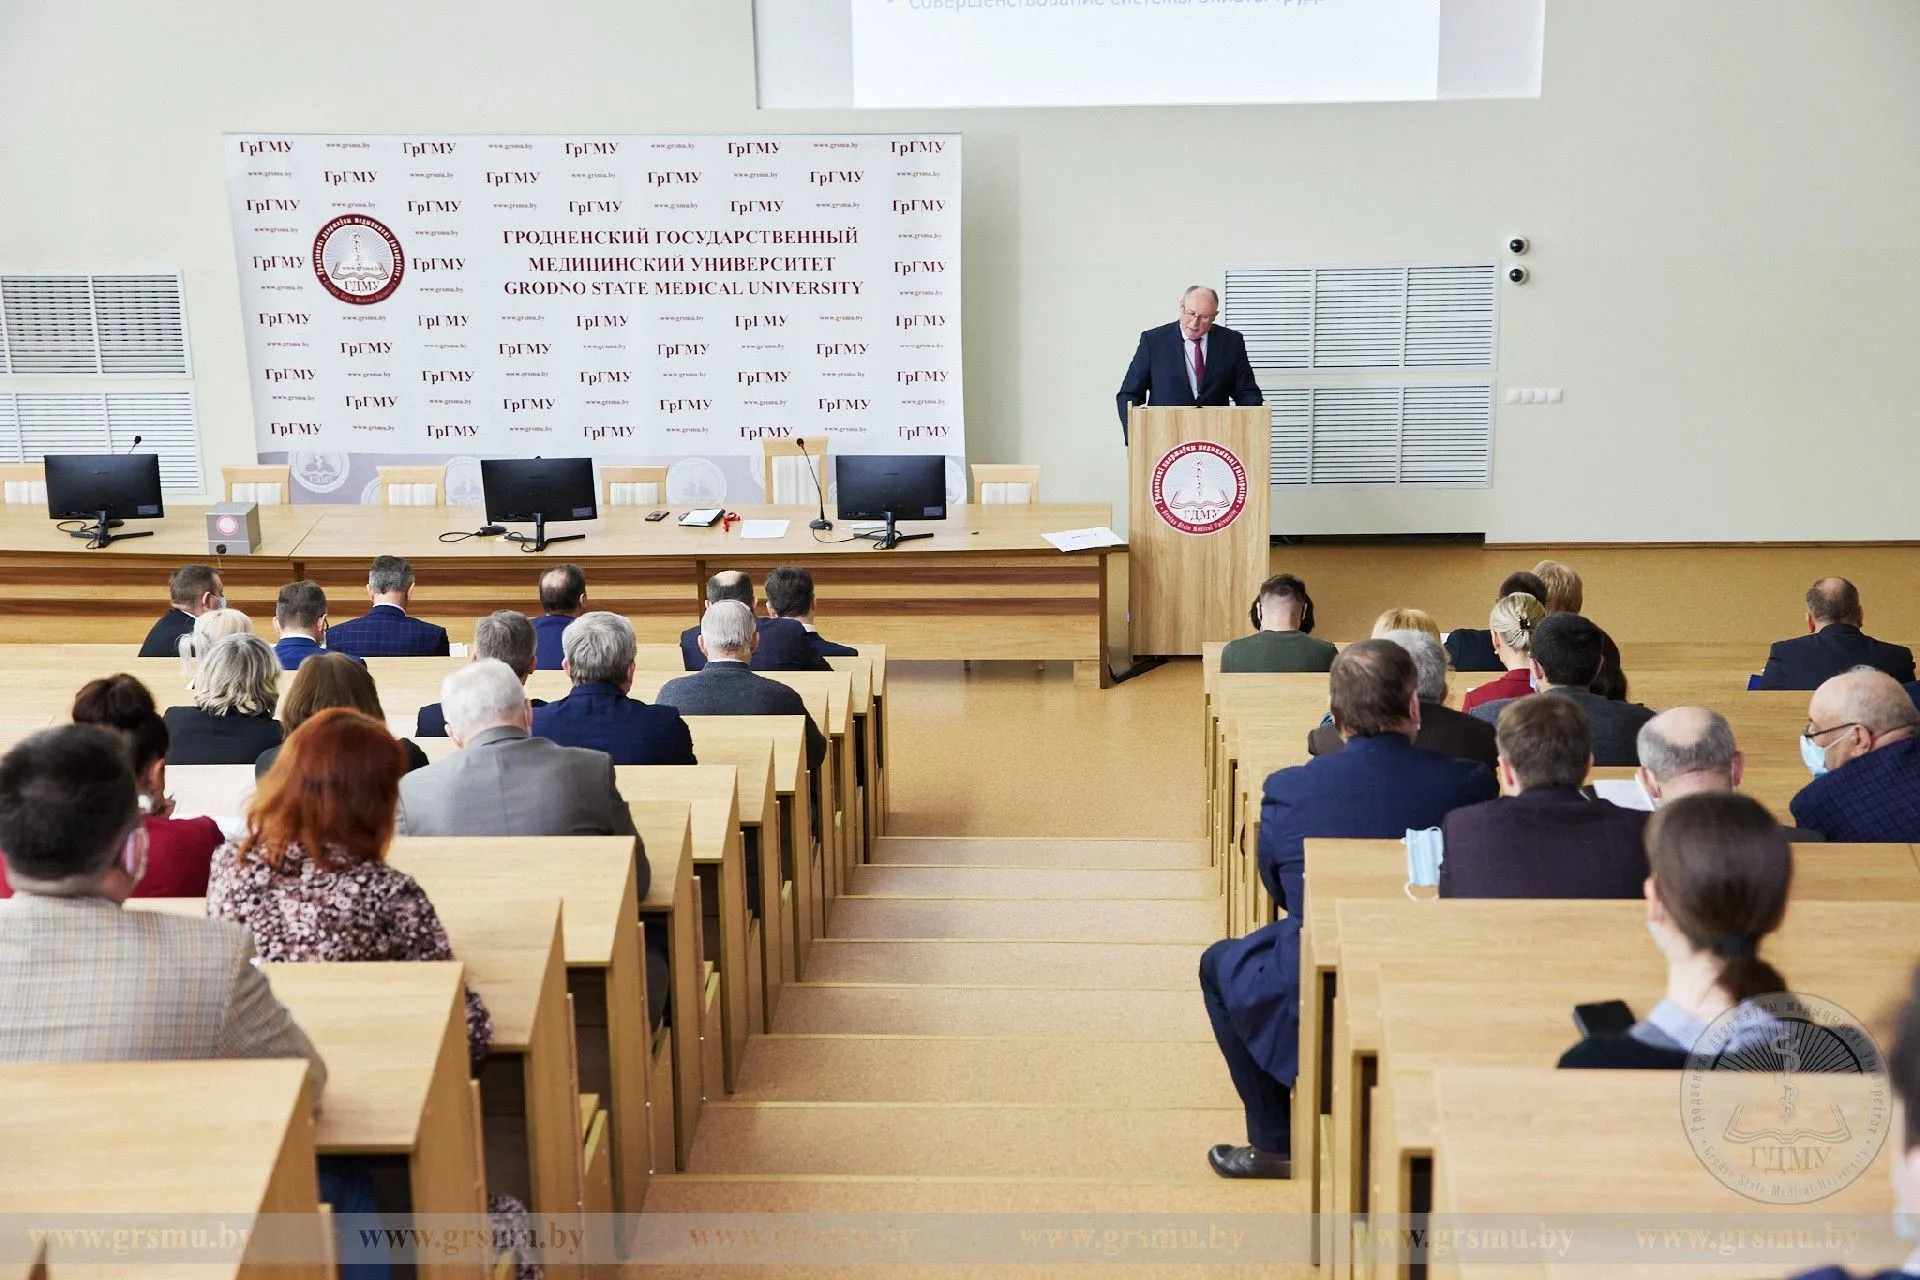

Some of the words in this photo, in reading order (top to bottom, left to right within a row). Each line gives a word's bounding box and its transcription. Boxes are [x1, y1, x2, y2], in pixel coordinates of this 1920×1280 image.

[240, 140, 293, 156] ГрГМУ
[403, 142, 456, 157] ГрГМУ
[565, 143, 618, 159] ГрГМУ
[728, 142, 782, 157] ГрГМУ
[891, 138, 945, 156] ГрГМУ
[324, 171, 377, 186] ГрГМУ
[486, 172, 540, 187] ГрГМУ
[648, 170, 703, 187] ГрГМУ
[809, 171, 864, 186] ГрГМУ
[247, 199, 300, 214] ГрГМУ
[408, 201, 462, 215] ГрГМУ
[569, 201, 622, 216] ГрГМУ
[729, 201, 784, 215] ГрГМУ
[889, 200, 945, 215] ГрГМУ
[503, 227, 649, 246] ГРОДНЕНСКИЙ
[656, 226, 857, 248] ГОСУДАРСТВЕННЫЙ
[253, 256, 305, 270] ГрГМУ
[412, 257, 466, 272] ГрГМУ
[528, 254, 685, 276] МЕДИЦИНСКИЙ
[690, 256, 837, 273] УНИВЕРСИТЕТ
[894, 260, 947, 275] ГрГМУ
[344, 280, 380, 292] ГДМУ
[504, 280, 586, 296] GRODNO
[592, 280, 648, 296] STATE
[655, 280, 743, 296] MEDICAL
[748, 280, 864, 296] UNIVERSITY
[259, 313, 311, 327] ГрГМУ
[417, 315, 469, 329] ГрГМУ
[577, 314, 628, 330] ГрГМУ
[736, 314, 788, 330] ГрГМУ
[896, 314, 946, 330] ГрГМУ
[341, 340, 392, 357] ГрГМУ
[499, 344, 552, 358] ГрГМУ
[657, 344, 710, 359] ГрГМУ
[817, 344, 869, 358] ГрГМУ
[265, 368, 316, 382] ГрГМУ
[422, 369, 474, 385] ГрГМУ
[580, 371, 632, 386] ГрГМУ
[736, 369, 791, 386] ГрГМУ
[897, 368, 949, 385] ГрГМУ
[346, 393, 398, 410] ГрГМУ
[503, 398, 556, 412] ГрГМУ
[656, 400, 712, 413] ГрГМУ
[819, 399, 870, 412] ГрГМУ
[270, 423, 322, 438] ГрГМУ
[427, 425, 479, 439] ГрГМУ
[584, 426, 635, 440] ГрГМУ
[740, 426, 793, 440] ГрГМУ
[899, 426, 950, 440] ГрГМУ
[1184, 510, 1220, 521] ГДМУ
